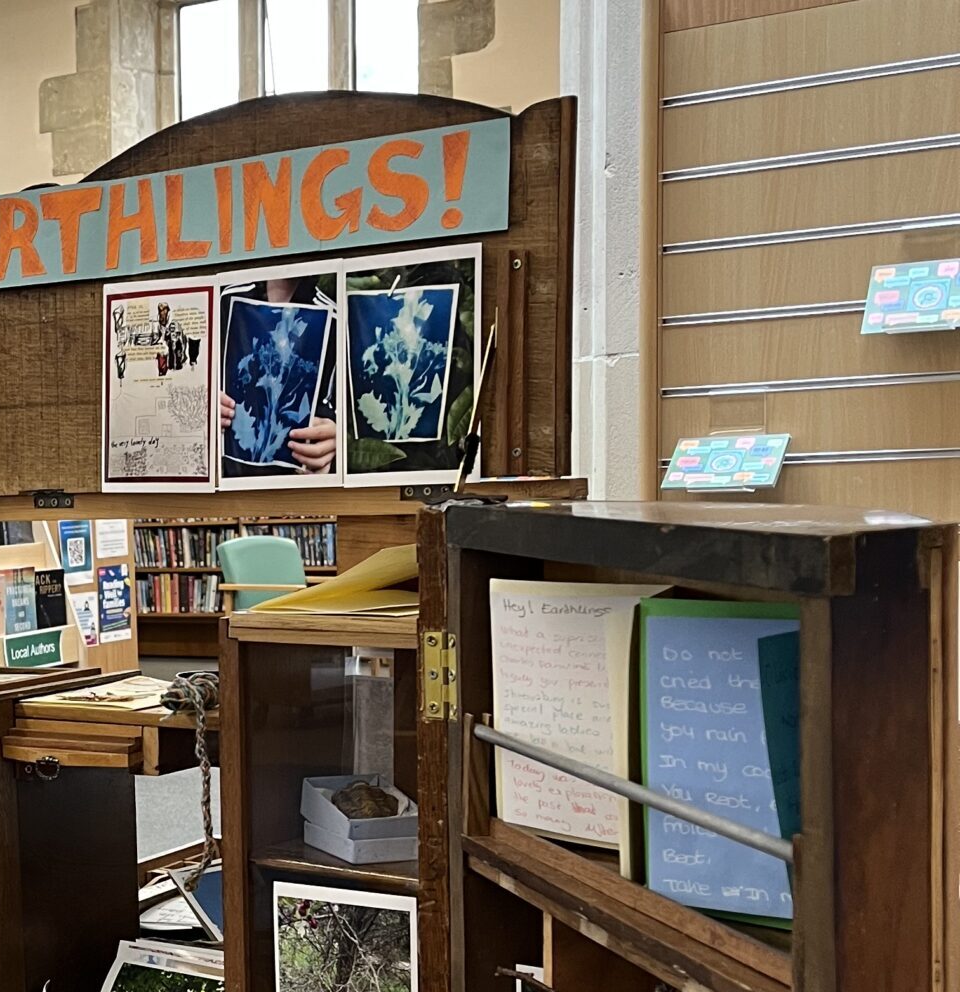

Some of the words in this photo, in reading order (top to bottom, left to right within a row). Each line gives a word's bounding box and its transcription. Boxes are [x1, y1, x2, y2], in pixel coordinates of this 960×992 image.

[503, 598, 534, 618] Hey!
[11, 645, 29, 660] Local
[30, 642, 56, 656] Authors
[663, 646, 693, 661] Do
[708, 647, 743, 662] not
[660, 695, 748, 714] Because
[706, 727, 748, 743] rain
[660, 754, 687, 769] In
[698, 760, 728, 782] my
[661, 783, 692, 801] You
[662, 879, 712, 896] Take
